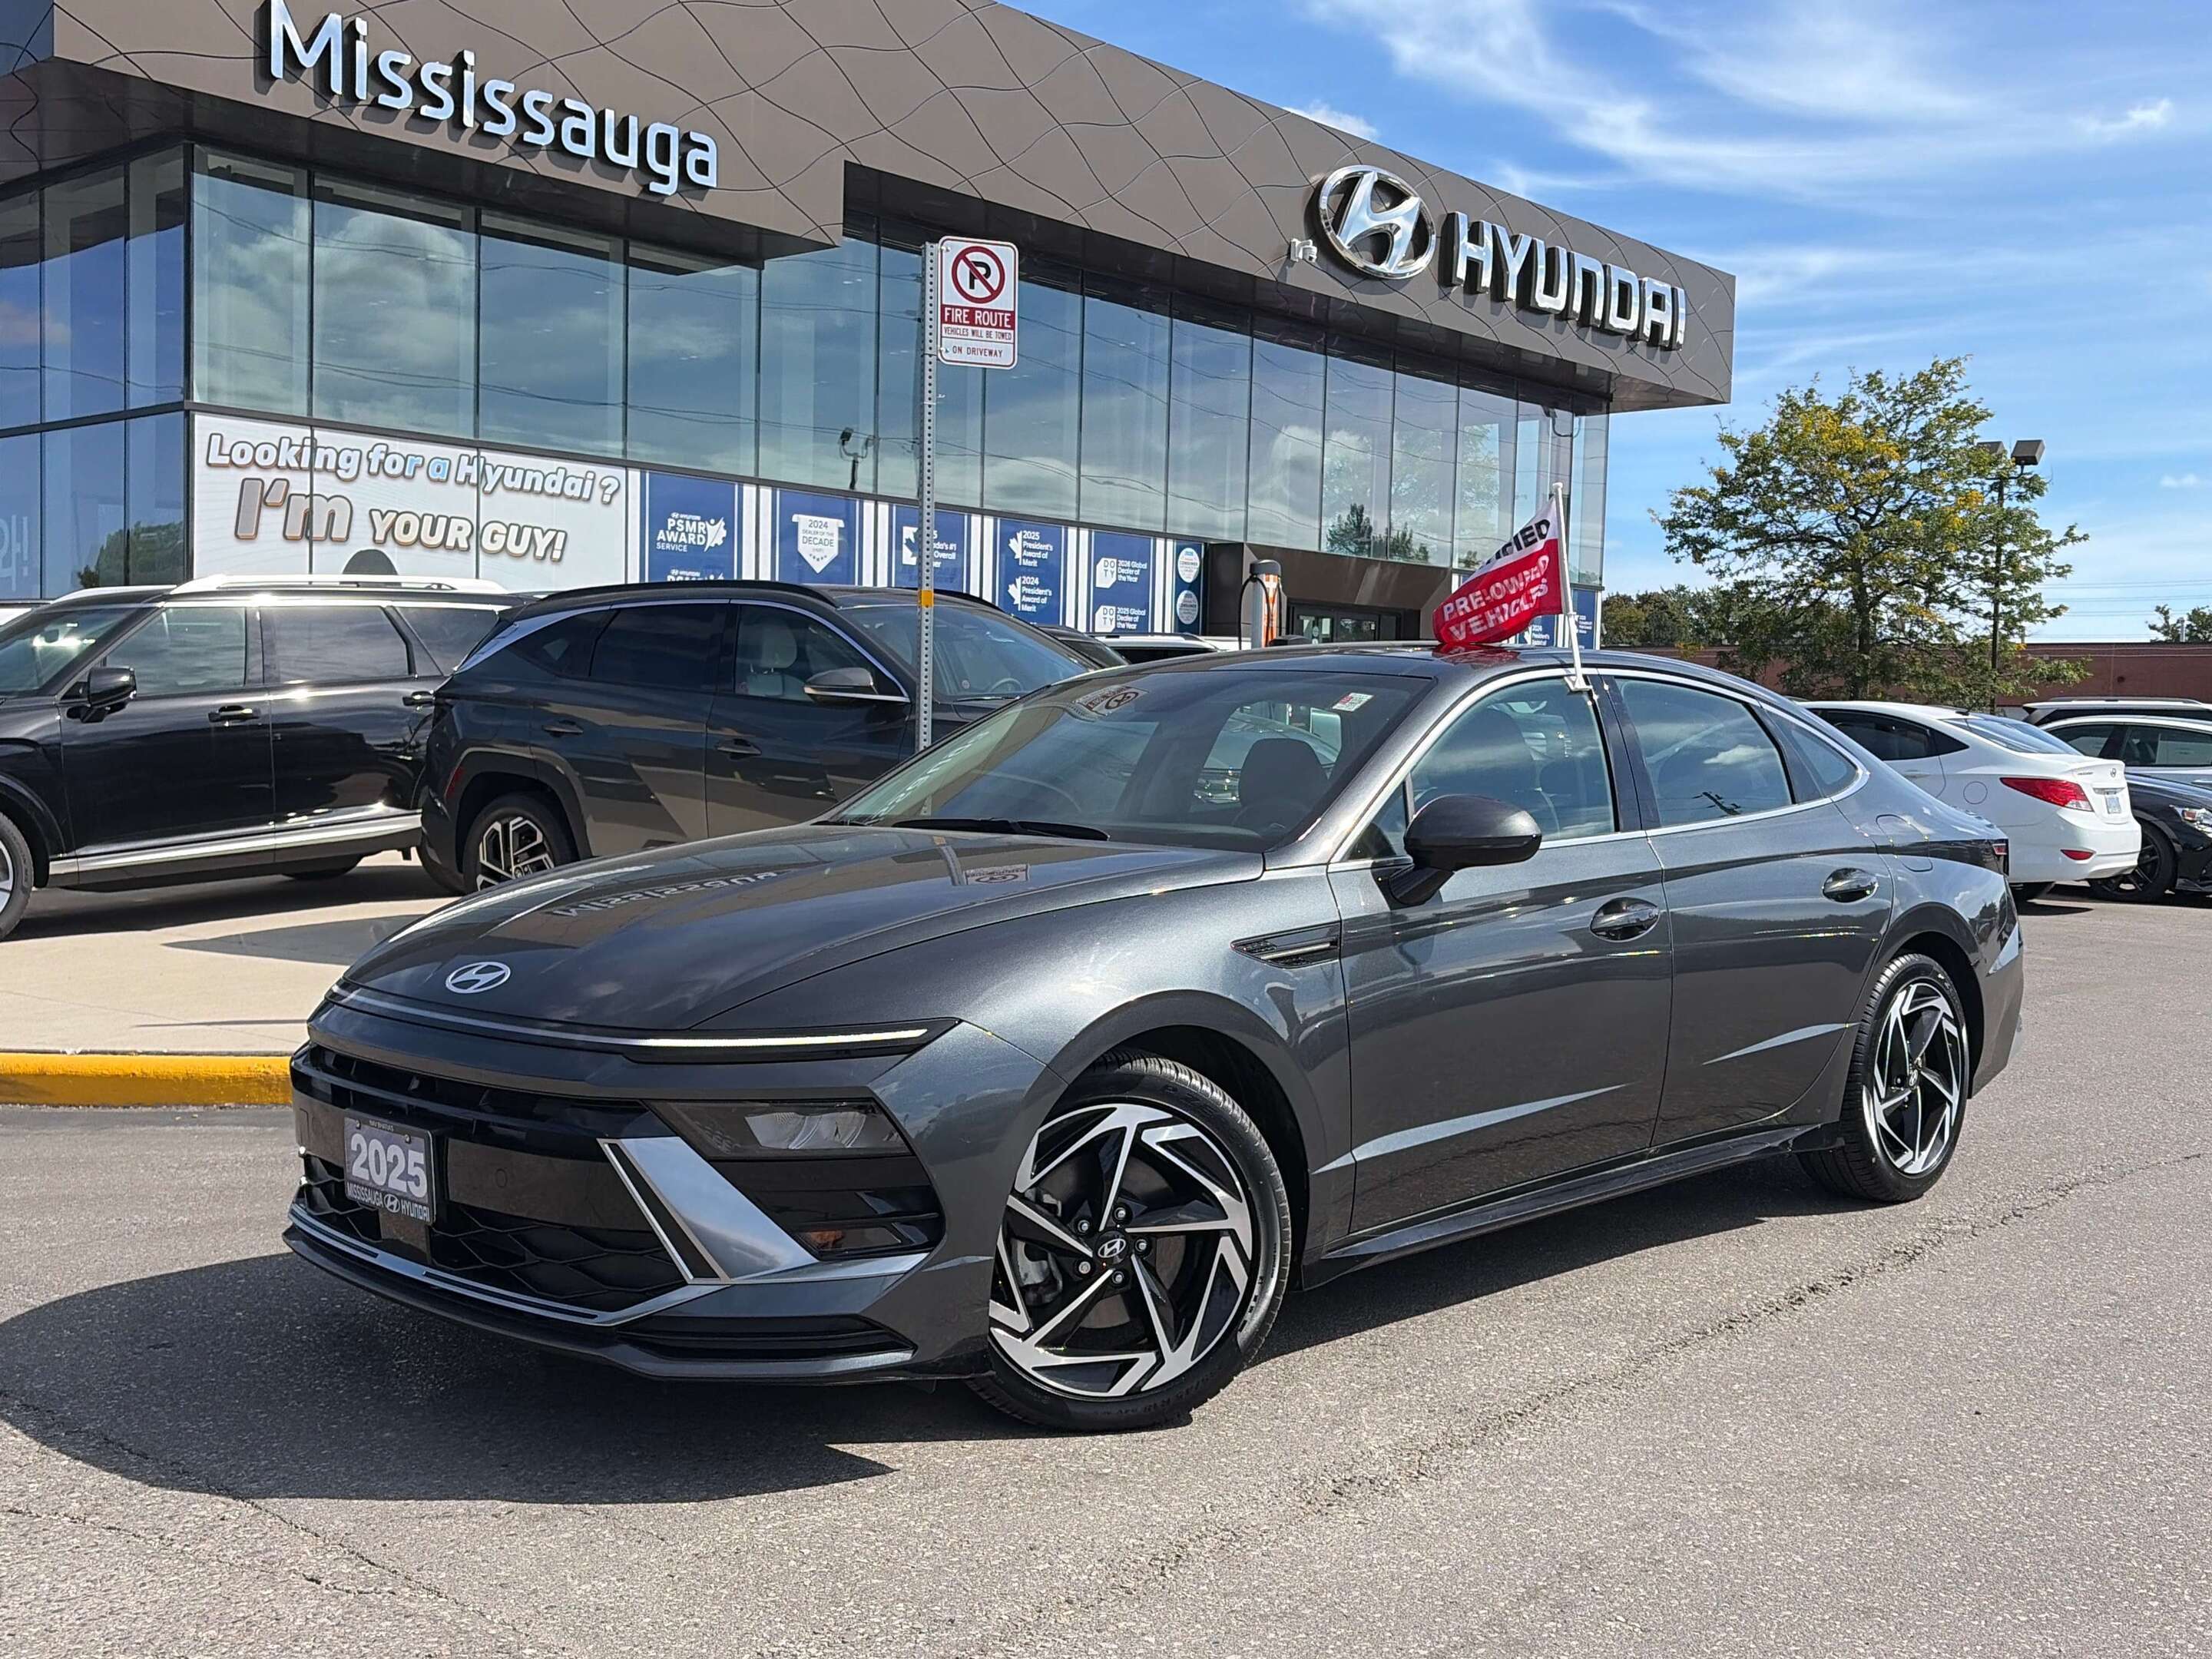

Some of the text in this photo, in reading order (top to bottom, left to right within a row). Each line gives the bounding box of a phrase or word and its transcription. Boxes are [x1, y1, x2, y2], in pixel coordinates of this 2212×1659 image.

[269, 0, 717, 196] Mississauga
[1452, 211, 1687, 351] HYUNDAI
[944, 307, 1012, 328] FIRE ROUTE
[944, 326, 1012, 340] VEHICLES WILL BE TOWED
[952, 346, 1002, 358] ON DRIVEWAY
[206, 433, 363, 481] Looking
[367, 442, 425, 478] for
[427, 455, 451, 482] a
[455, 454, 596, 501] Hyundai
[234, 477, 568, 562] I'm YOUR GUY!
[808, 519, 829, 528] 2024
[667, 518, 706, 535] PSMR
[657, 530, 706, 546] AWARD
[1022, 530, 1040, 540] 2025
[656, 542, 688, 552] SERVICE
[802, 536, 834, 547] DECADE
[1022, 541, 1053, 551] President's
[1022, 551, 1041, 559] Award
[1022, 576, 1039, 585] 2024
[1022, 586, 1052, 596] President's
[1021, 595, 1040, 604] Award
[1021, 604, 1037, 613] Merit
[350, 1133, 428, 1198] 2025
[346, 1181, 431, 1223] MISSISSAUGA HYUNDAI
